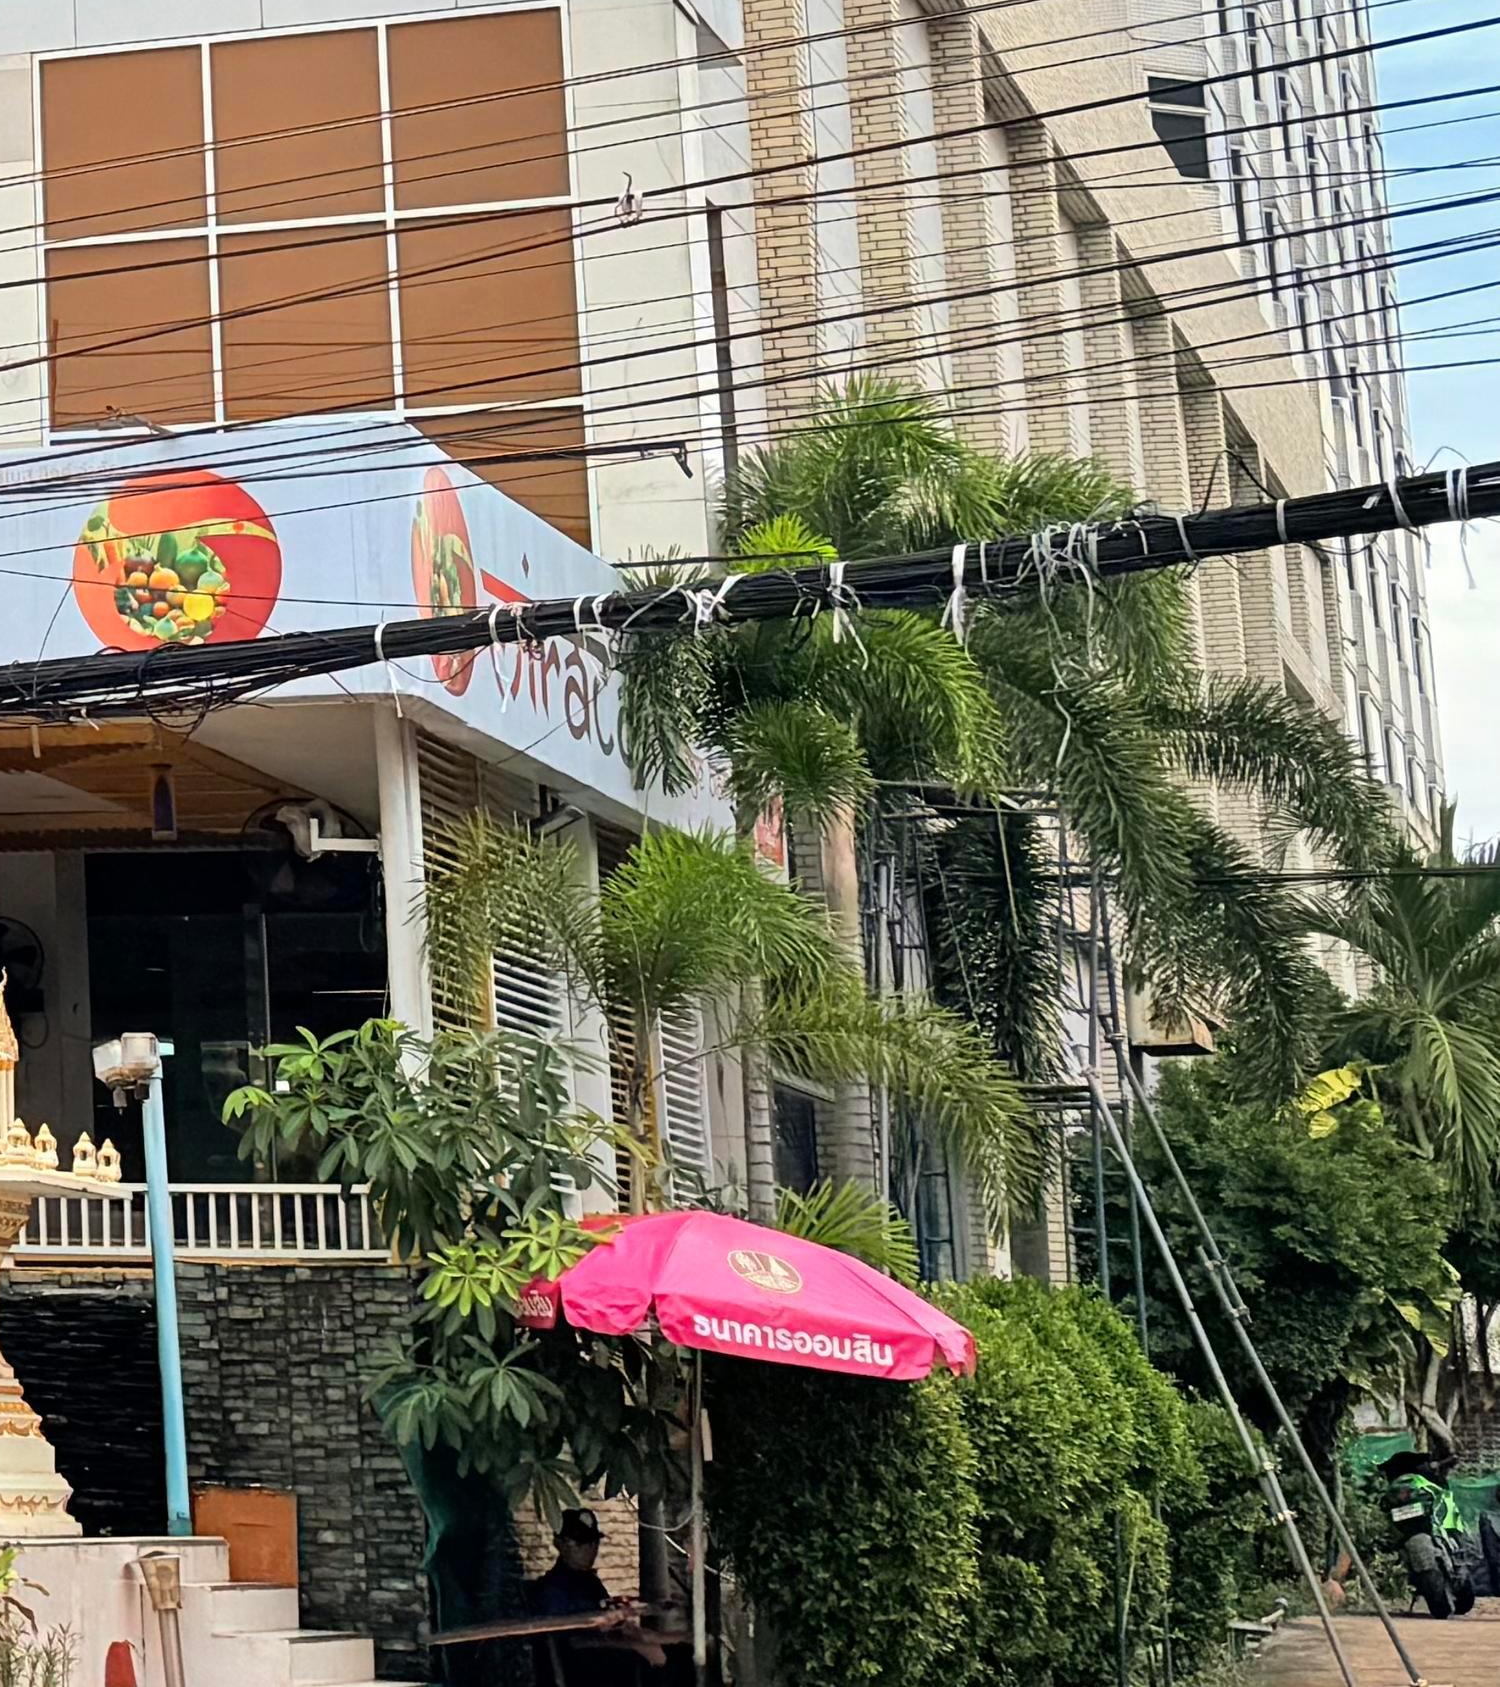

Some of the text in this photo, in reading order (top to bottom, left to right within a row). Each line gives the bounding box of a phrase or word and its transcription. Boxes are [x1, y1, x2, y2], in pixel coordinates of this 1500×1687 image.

[692, 1313, 895, 1367] ธนาคารออมสิน
